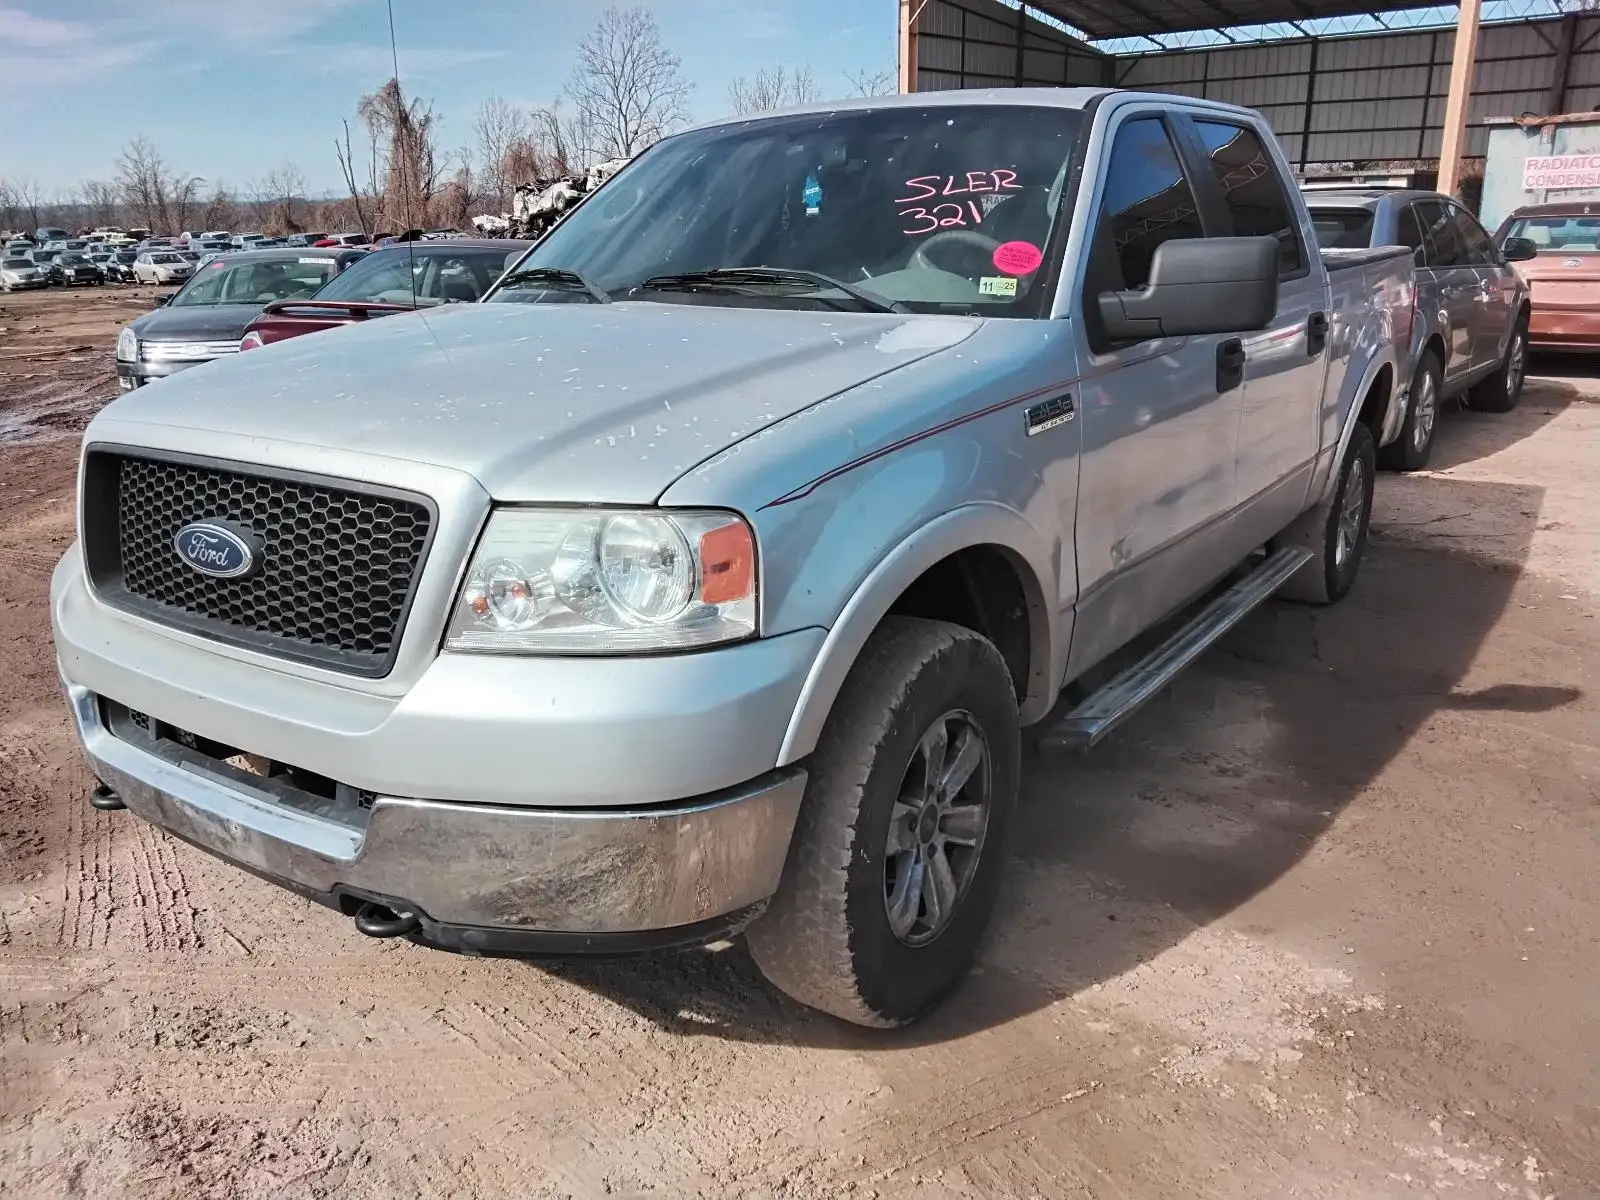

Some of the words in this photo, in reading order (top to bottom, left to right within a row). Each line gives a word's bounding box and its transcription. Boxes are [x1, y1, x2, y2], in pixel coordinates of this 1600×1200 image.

[1526, 156, 1600, 171] RADIATO
[894, 169, 1023, 202] SLER
[898, 200, 982, 234] 321
[982, 281, 994, 292] 11
[1003, 281, 1015, 290] 25
[187, 532, 230, 567] Ford
